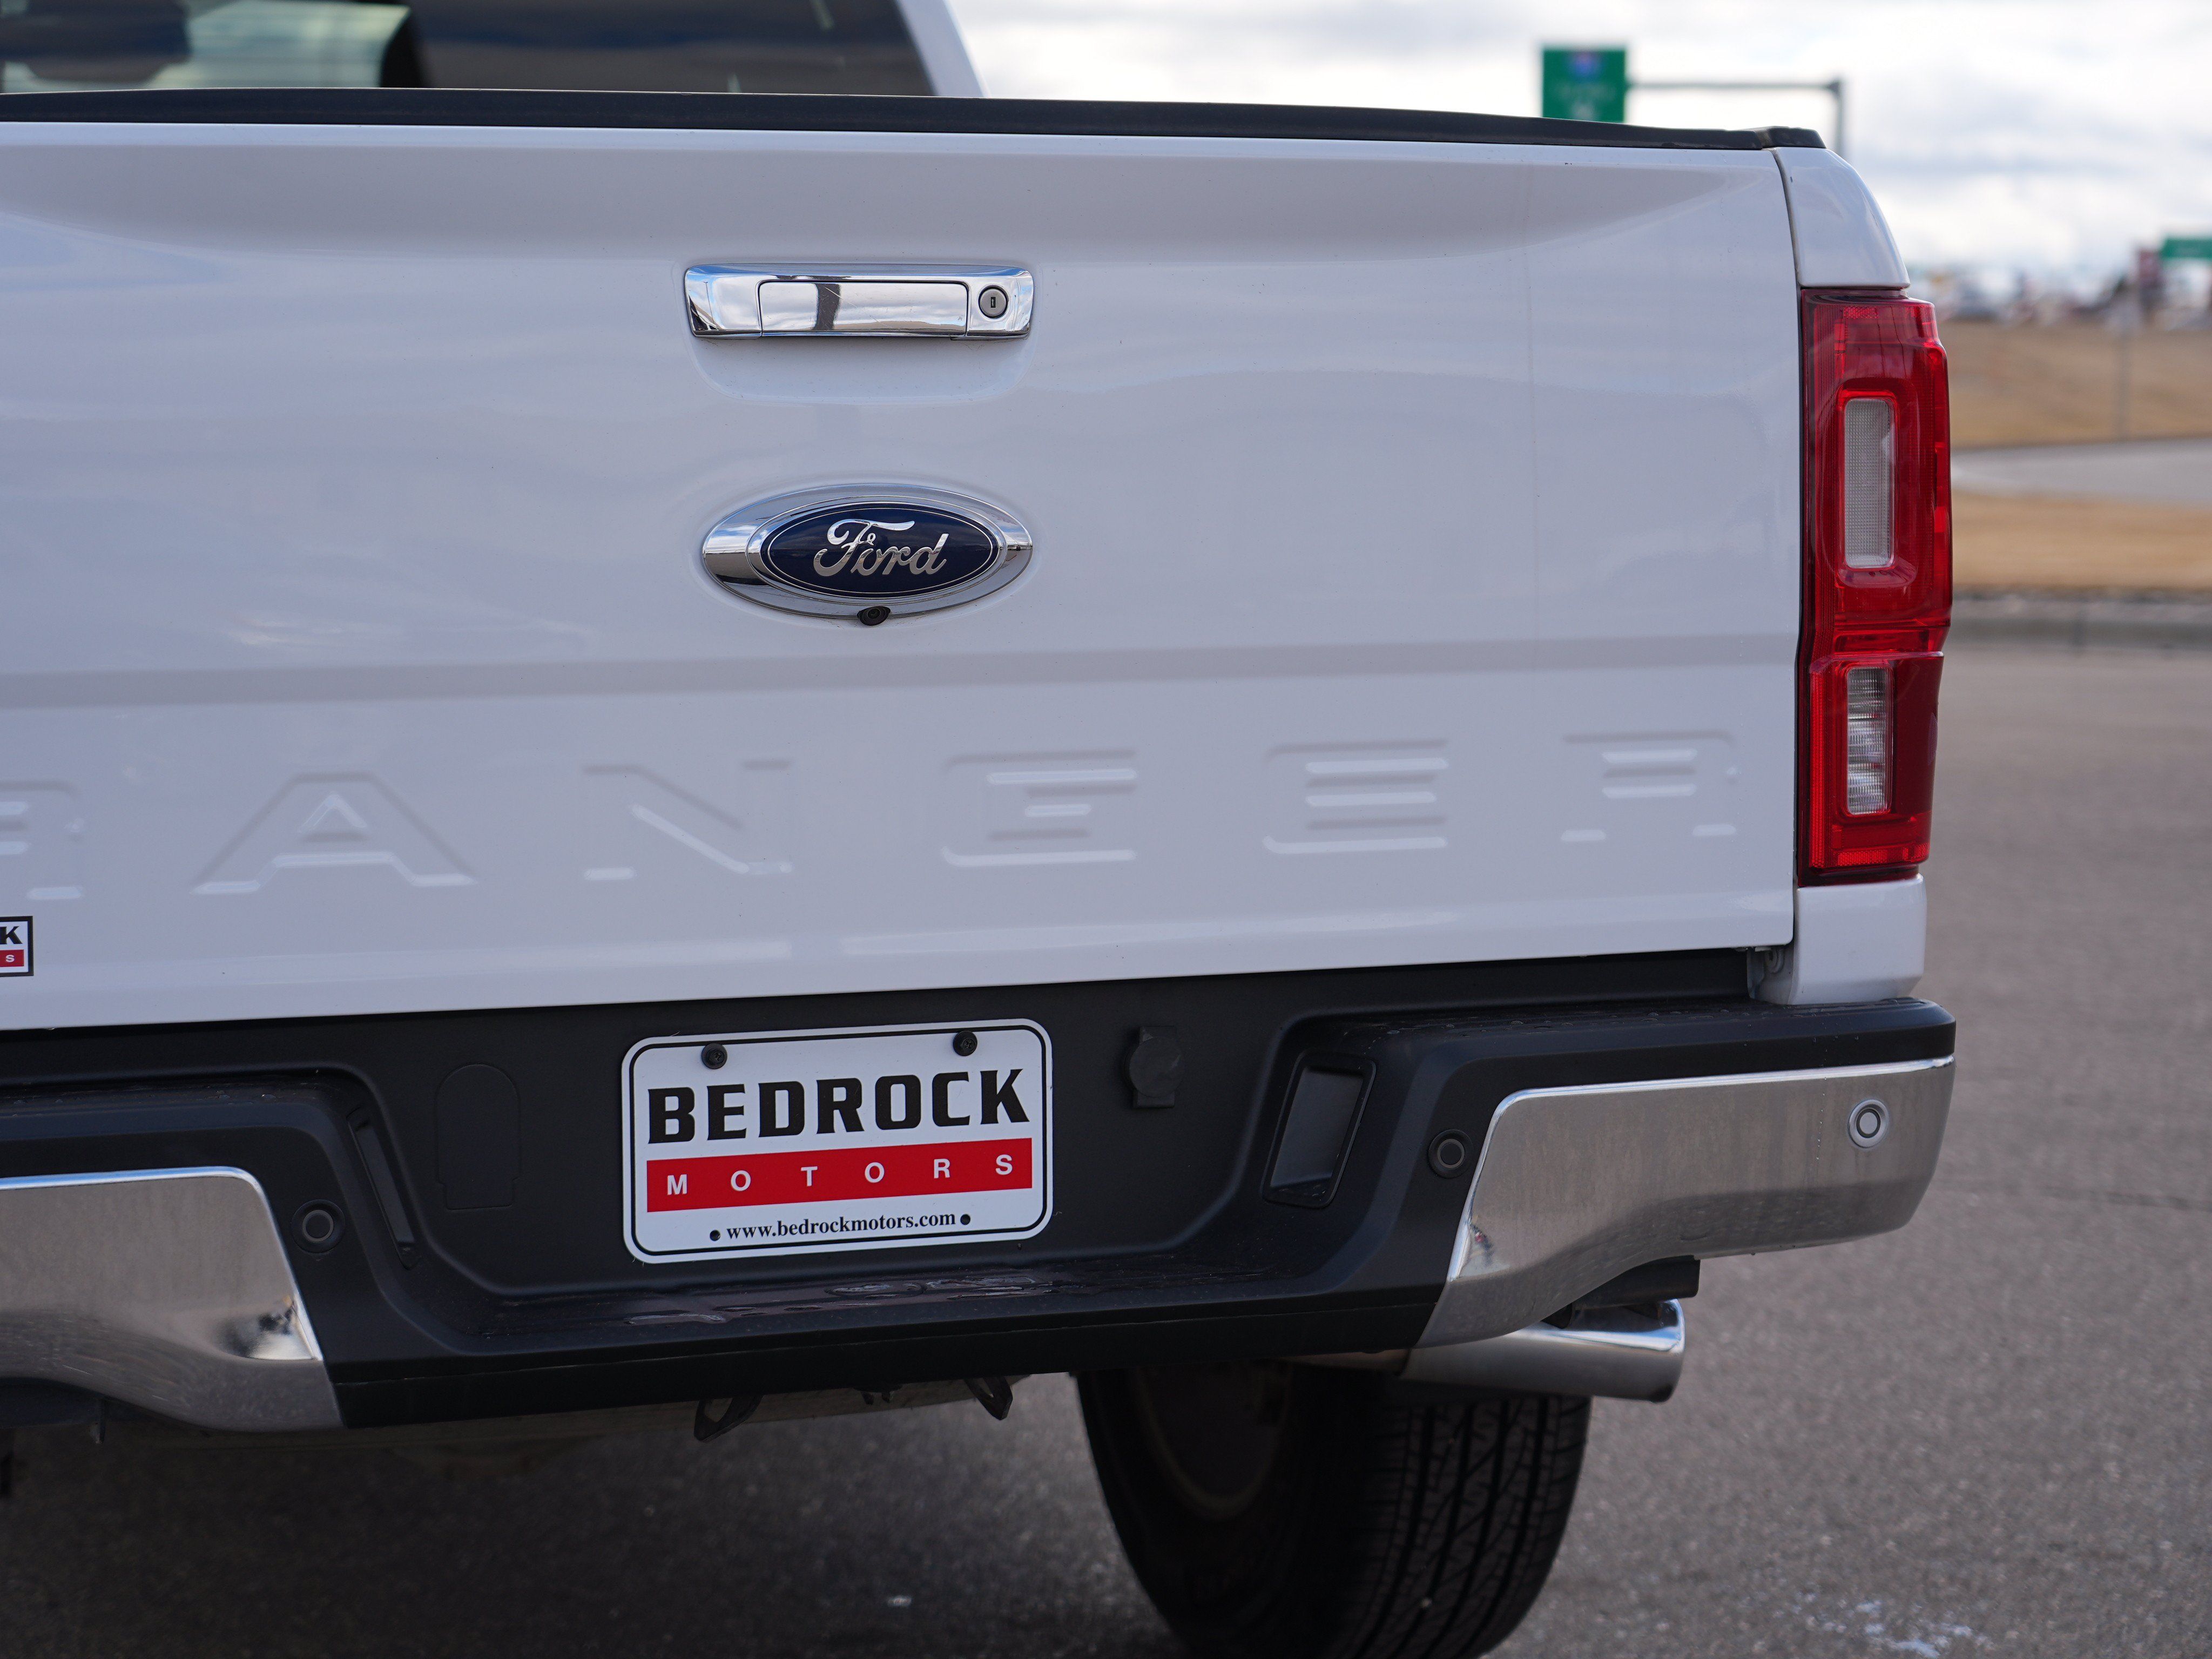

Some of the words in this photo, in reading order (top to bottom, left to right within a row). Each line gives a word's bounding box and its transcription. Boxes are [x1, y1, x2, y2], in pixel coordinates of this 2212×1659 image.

[813, 518, 949, 577] Ford
[648, 1069, 1029, 1144] BEDROCK
[666, 1154, 1014, 1195] MOTORS
[726, 1212, 956, 1240] www.bedrockmotors.com
